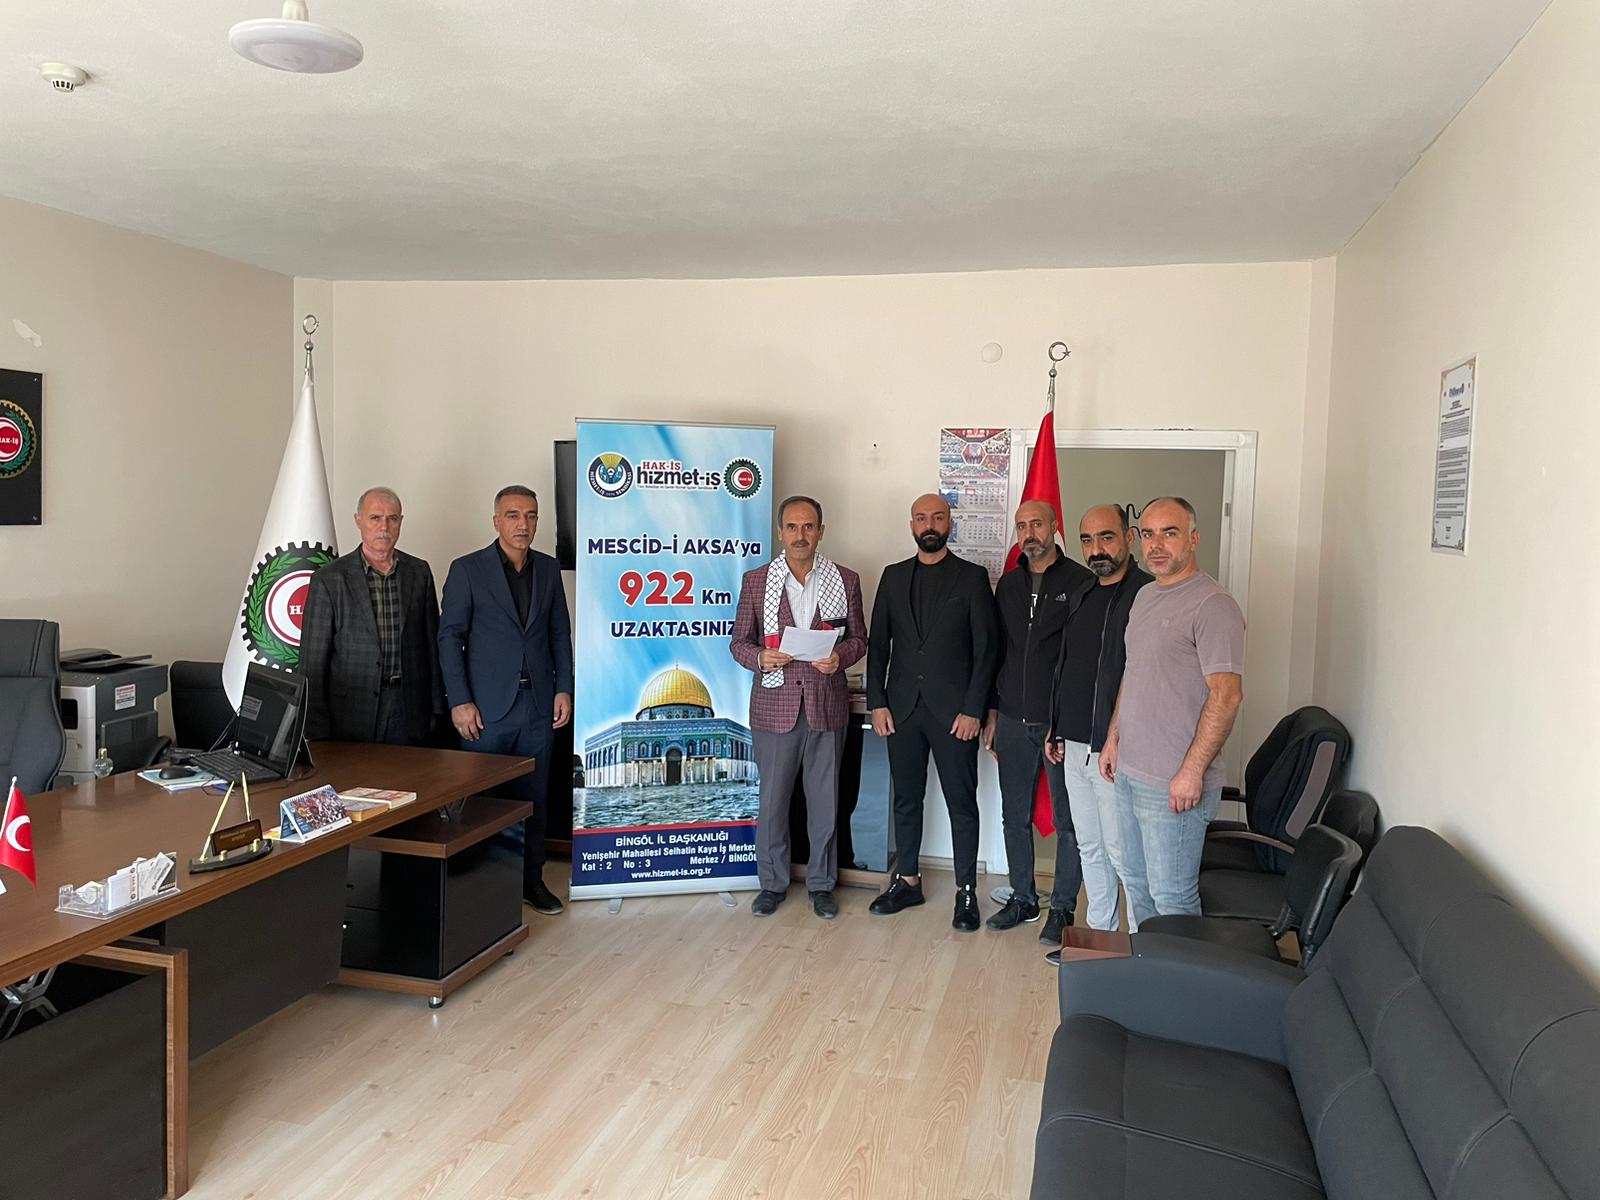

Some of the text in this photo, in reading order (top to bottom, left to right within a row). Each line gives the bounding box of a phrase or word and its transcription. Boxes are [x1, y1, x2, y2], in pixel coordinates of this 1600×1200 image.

[683, 539, 761, 557] AKSA'ya
[620, 571, 731, 606] 922 Km
[616, 831, 728, 846] BİNGÖL İL BAŞKANLIĞI
[582, 851, 620, 861] Yenişehir
[622, 848, 661, 858] Mahallesi
[698, 846, 717, 854] Kaya
[719, 843, 726, 854] İş
[582, 863, 596, 871] Kat
[606, 862, 612, 870] 2
[623, 860, 635, 868] No
[645, 859, 651, 867] 3
[690, 856, 718, 865] Merkez
[721, 855, 726, 863] /
[729, 852, 757, 862] BİNGÖL
[631, 867, 712, 878] www.hizmet-is.org.tr
